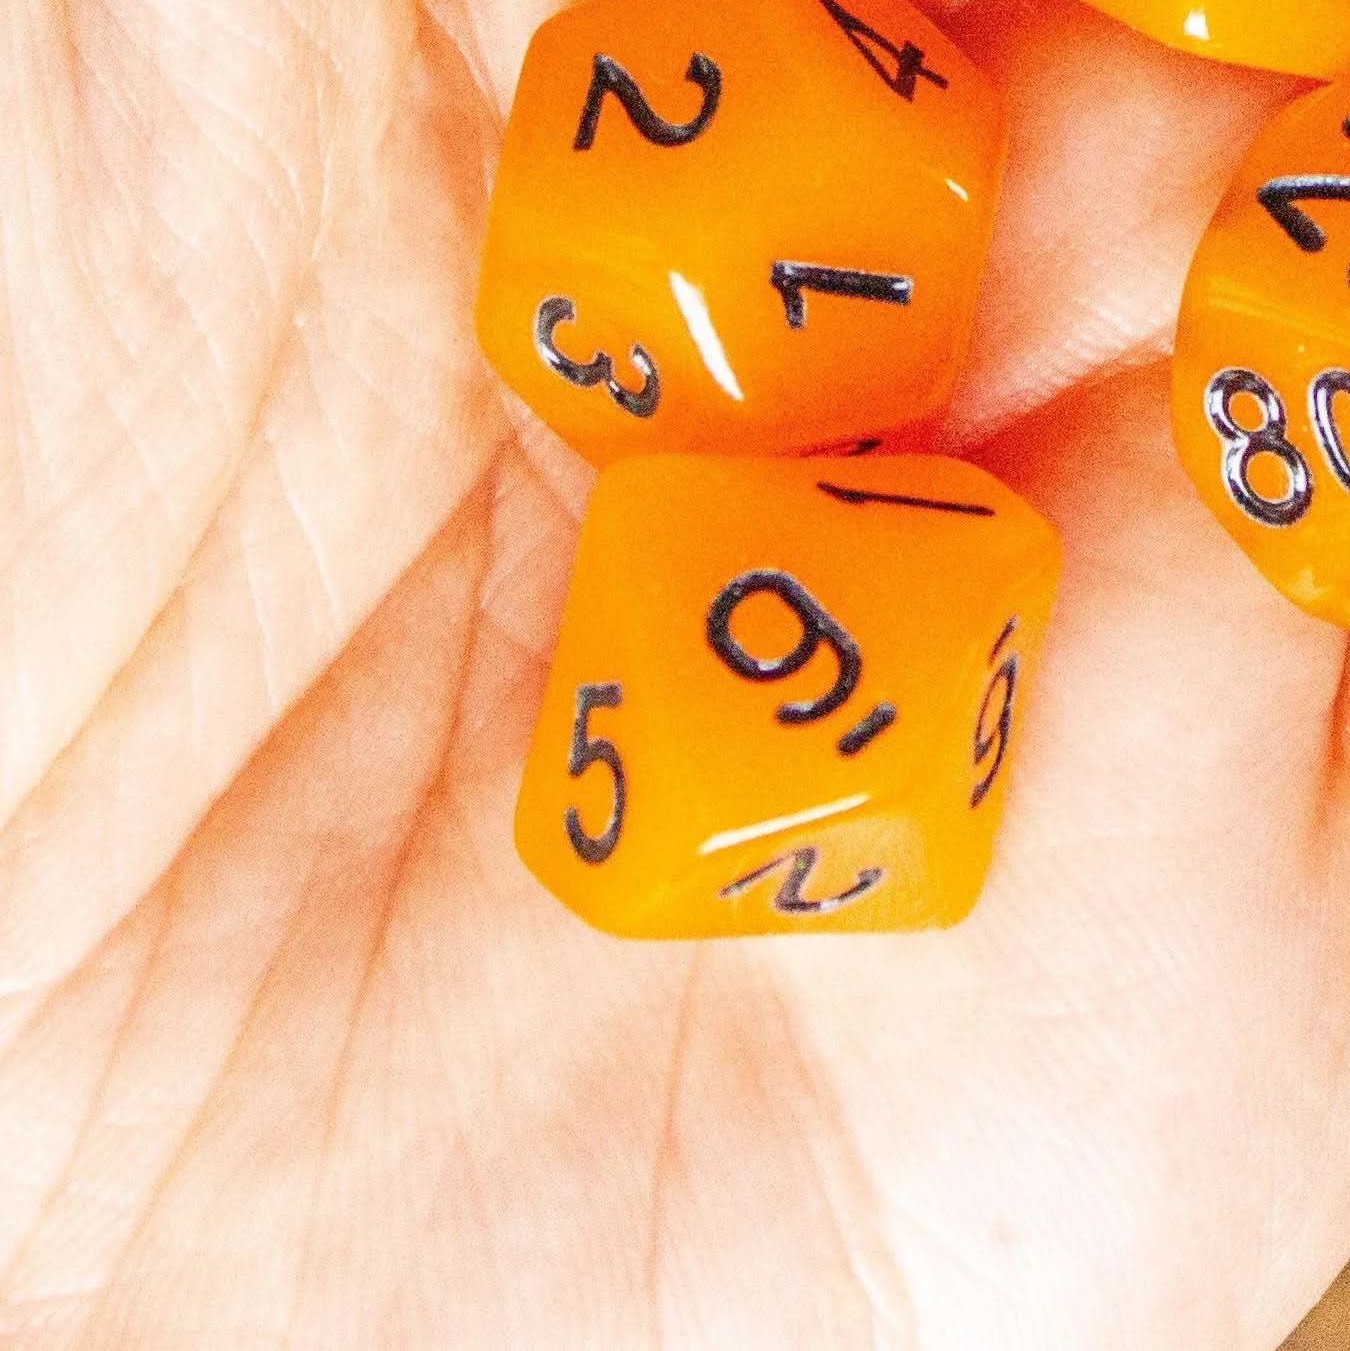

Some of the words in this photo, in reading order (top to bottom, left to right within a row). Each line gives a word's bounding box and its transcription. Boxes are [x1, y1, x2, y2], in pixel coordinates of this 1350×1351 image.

[572, 51, 724, 152] 2
[768, 261, 912, 331] 1
[536, 296, 662, 420] 3
[564, 683, 627, 865] 5
[722, 847, 883, 914] 2
